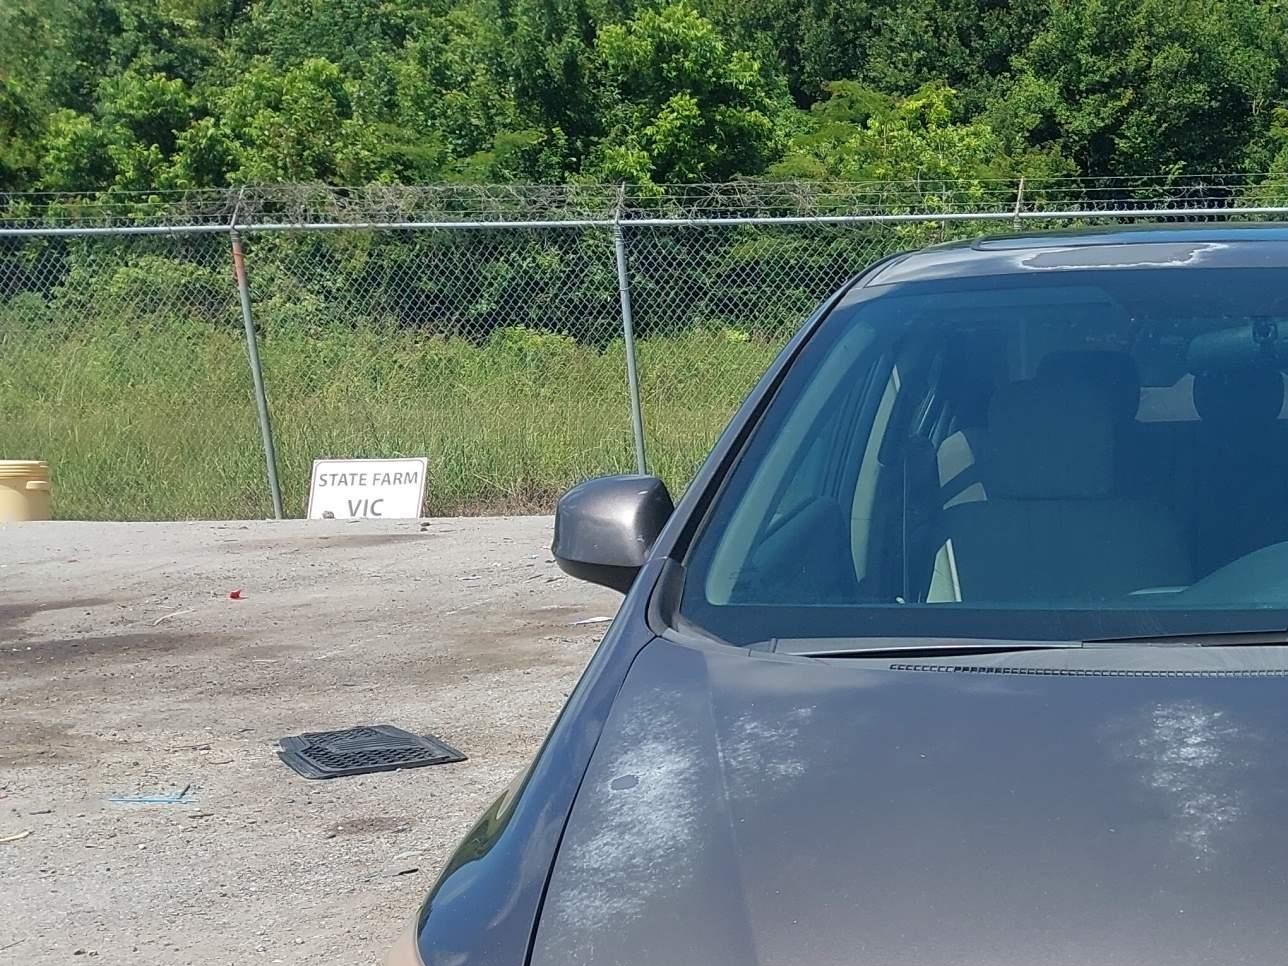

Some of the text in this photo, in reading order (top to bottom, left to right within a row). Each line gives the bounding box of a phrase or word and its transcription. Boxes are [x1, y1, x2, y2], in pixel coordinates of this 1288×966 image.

[319, 471, 418, 487] STATE FARM
[348, 498, 384, 517] VIC
